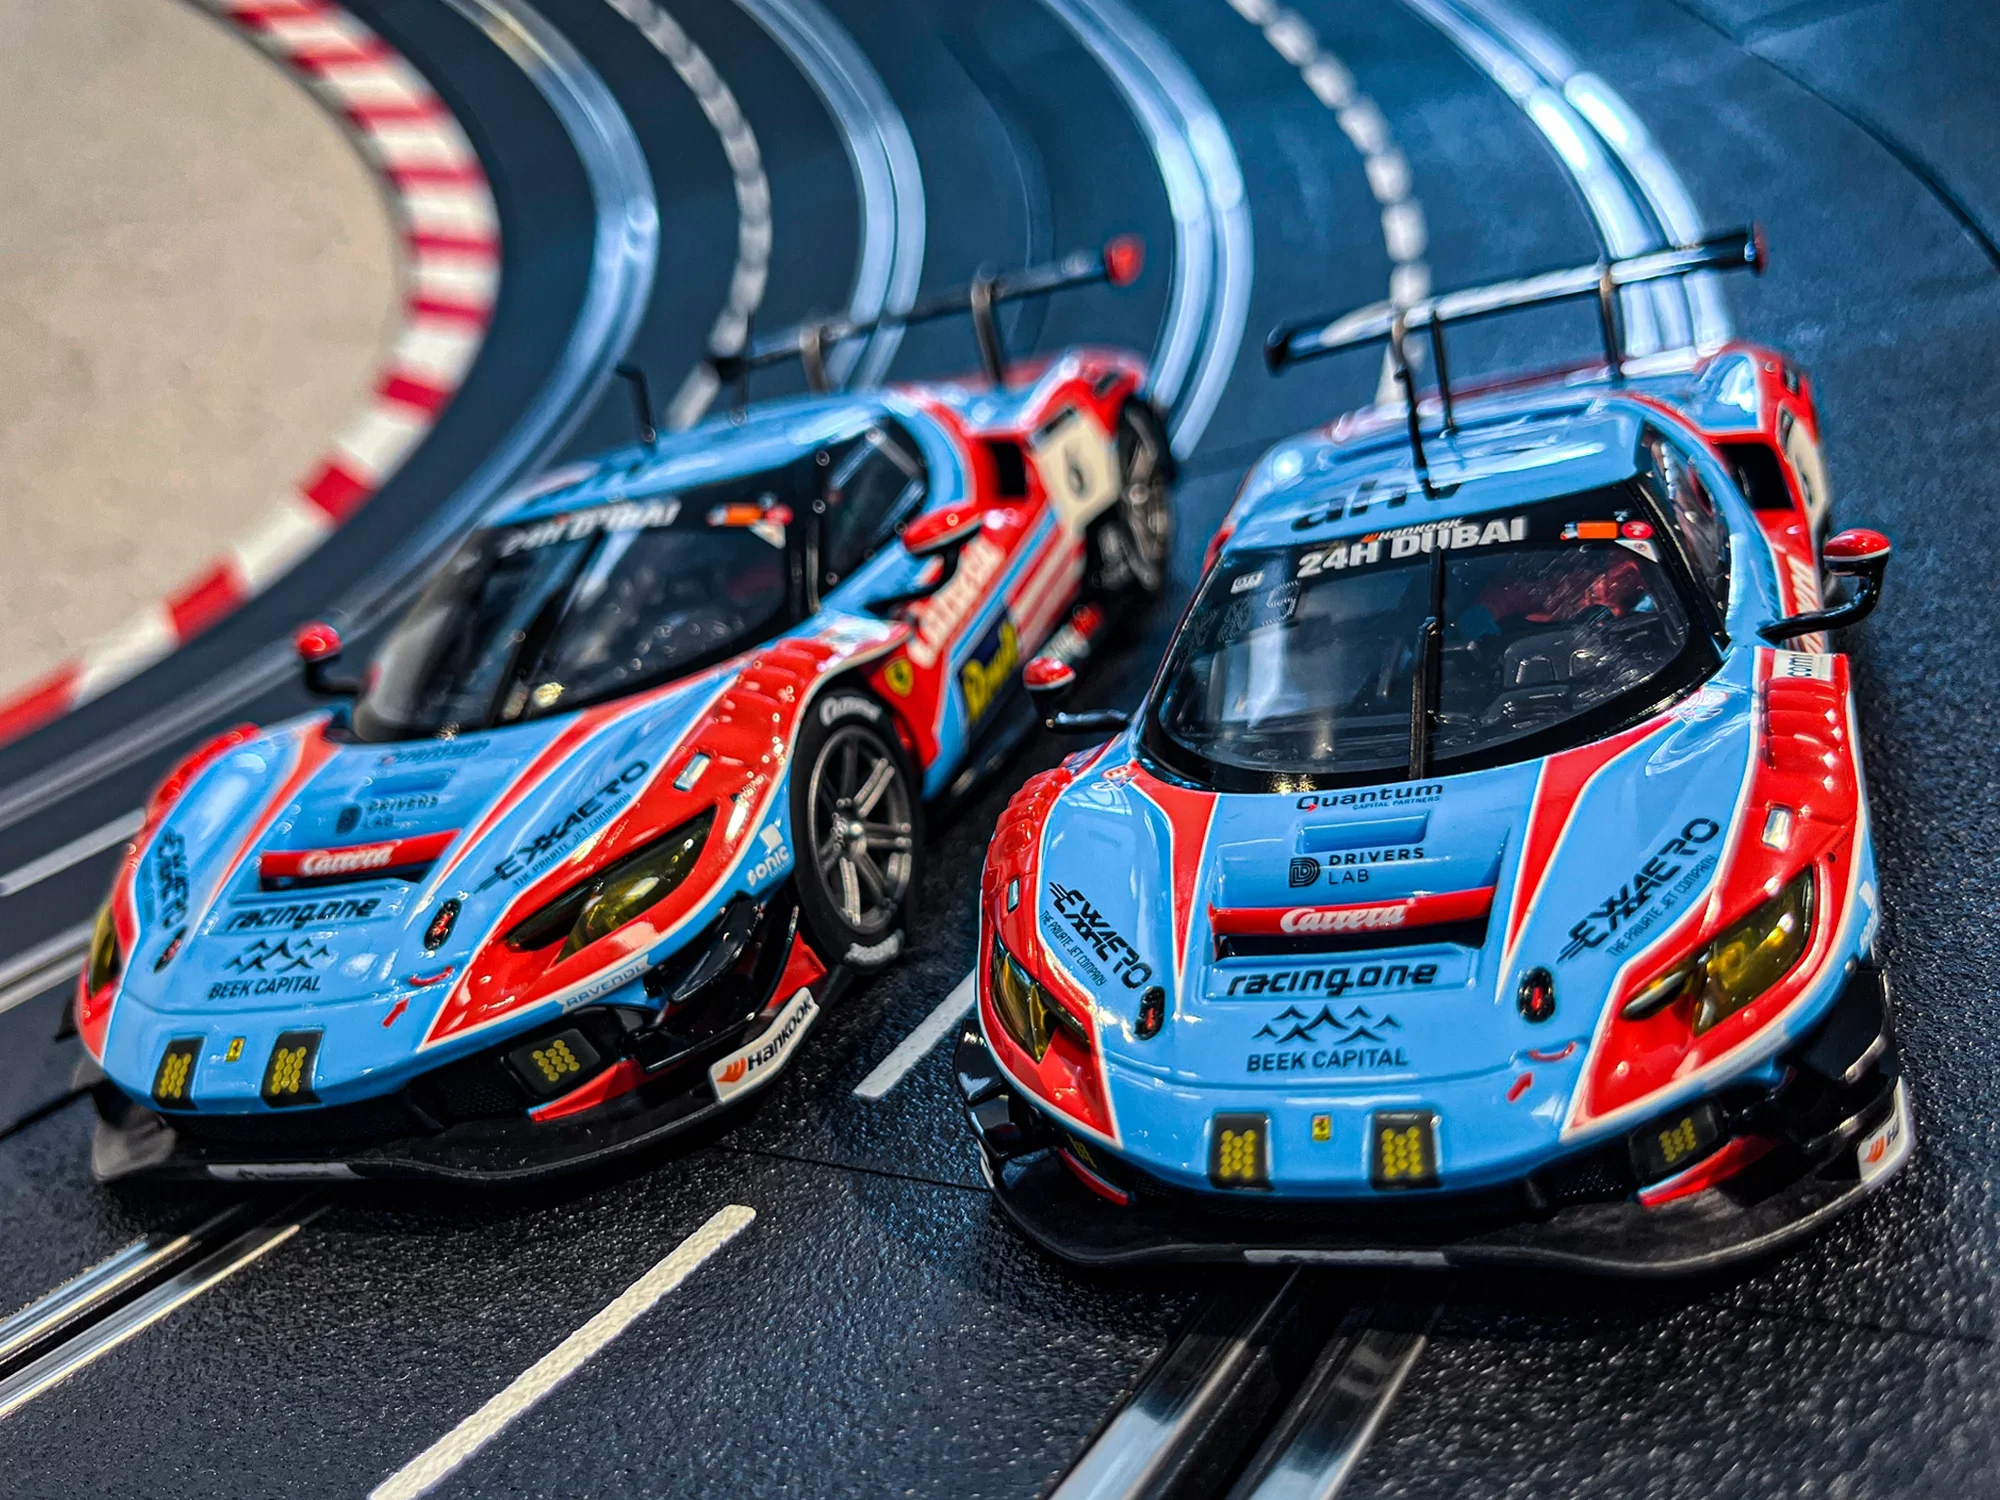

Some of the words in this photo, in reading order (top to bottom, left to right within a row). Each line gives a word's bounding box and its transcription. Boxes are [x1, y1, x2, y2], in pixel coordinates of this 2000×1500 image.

[1296, 540, 1380, 578] 24H
[1390, 516, 1529, 559] DUBAI
[1296, 784, 1443, 812] Quantum
[1352, 801, 1389, 810] CAPITAL
[1392, 795, 1441, 806] PARTNERS
[1328, 847, 1425, 866] DRIVERS
[1328, 868, 1369, 885] LAB
[1606, 936, 1628, 956] THE
[1661, 890, 1678, 909] JET
[1674, 854, 1718, 895] COMPANY
[1280, 905, 1406, 933] Carrera
[1039, 910, 1054, 926] THE
[1067, 945, 1082, 959] JET
[1076, 953, 1107, 986] COMPANY
[208, 979, 253, 1000] BEEK
[254, 975, 321, 995] CAPITAL
[1246, 1051, 1306, 1072] BEEK
[1312, 1046, 1409, 1070] CAPITAL
